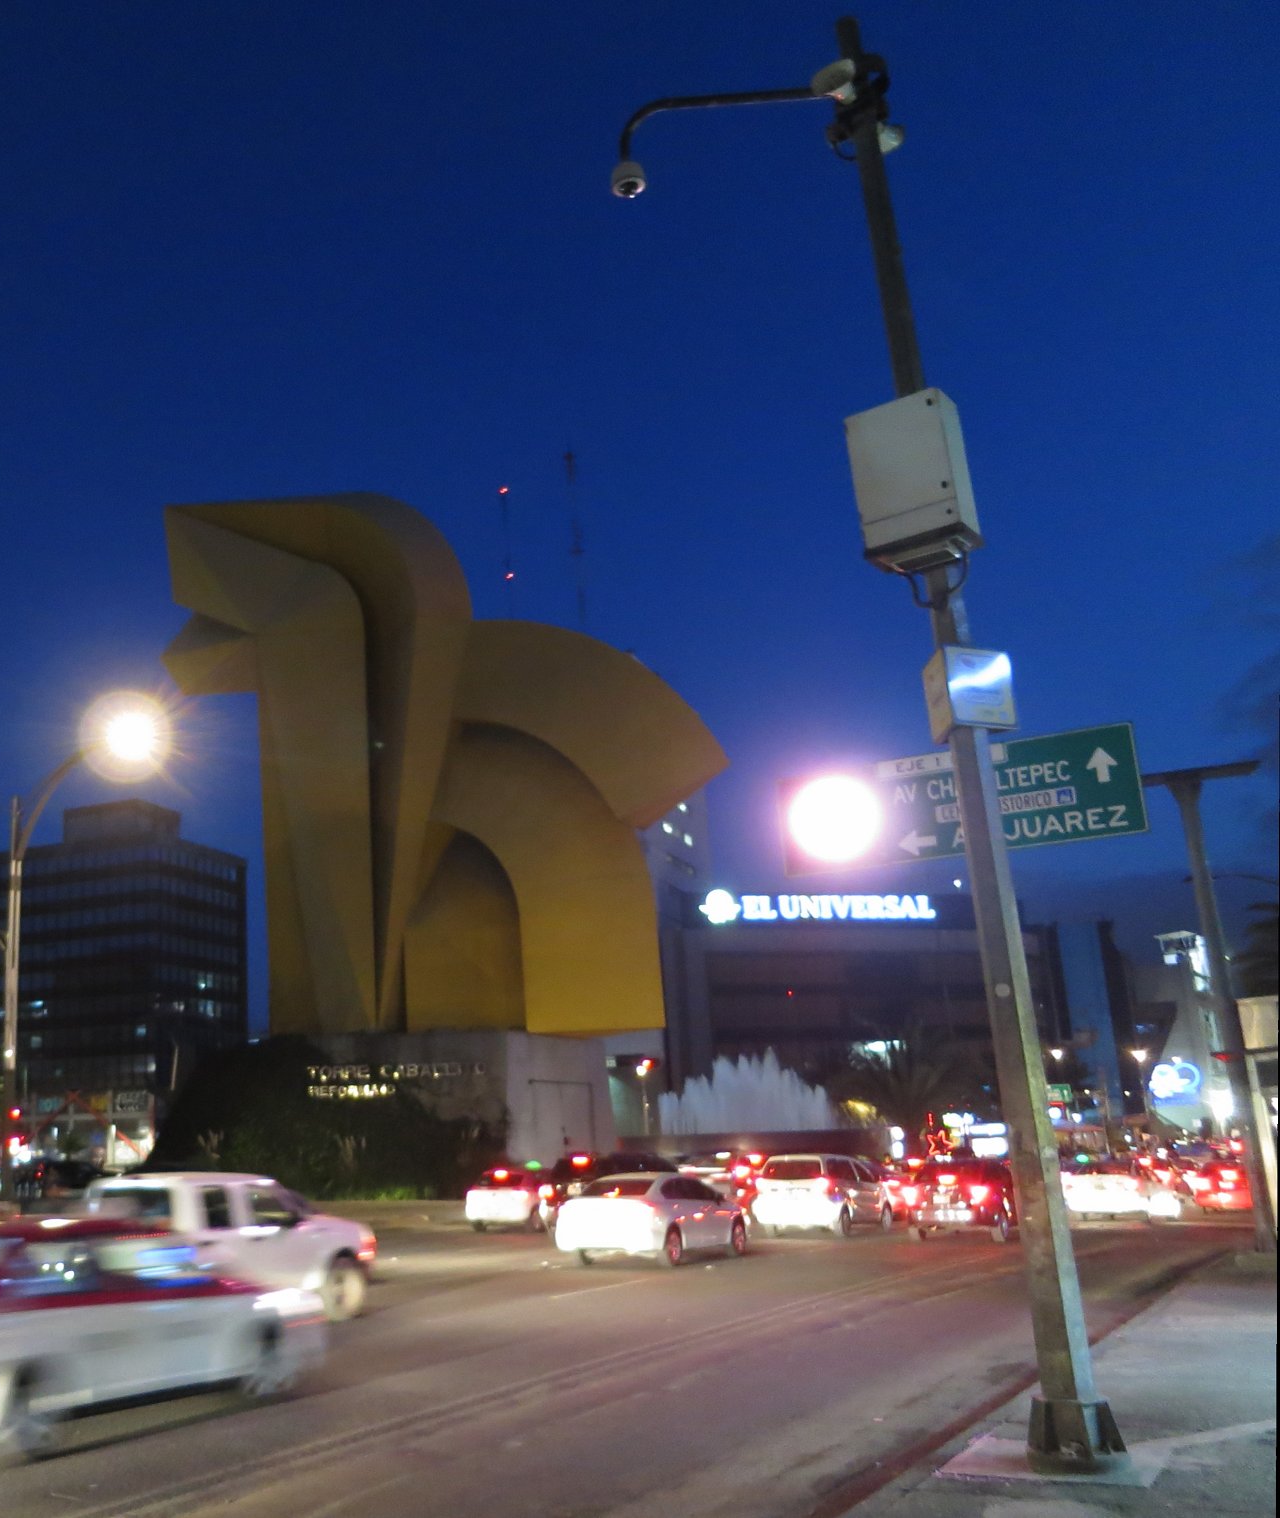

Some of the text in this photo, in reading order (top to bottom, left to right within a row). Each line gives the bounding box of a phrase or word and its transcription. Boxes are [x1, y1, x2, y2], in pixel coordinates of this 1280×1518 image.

[895, 758, 925, 773] EJE
[894, 783, 917, 803] AV
[1004, 805, 1129, 840] JUAREZ
[741, 894, 937, 919] EL UNIVERSAL
[307, 1065, 371, 1081] TORRE
